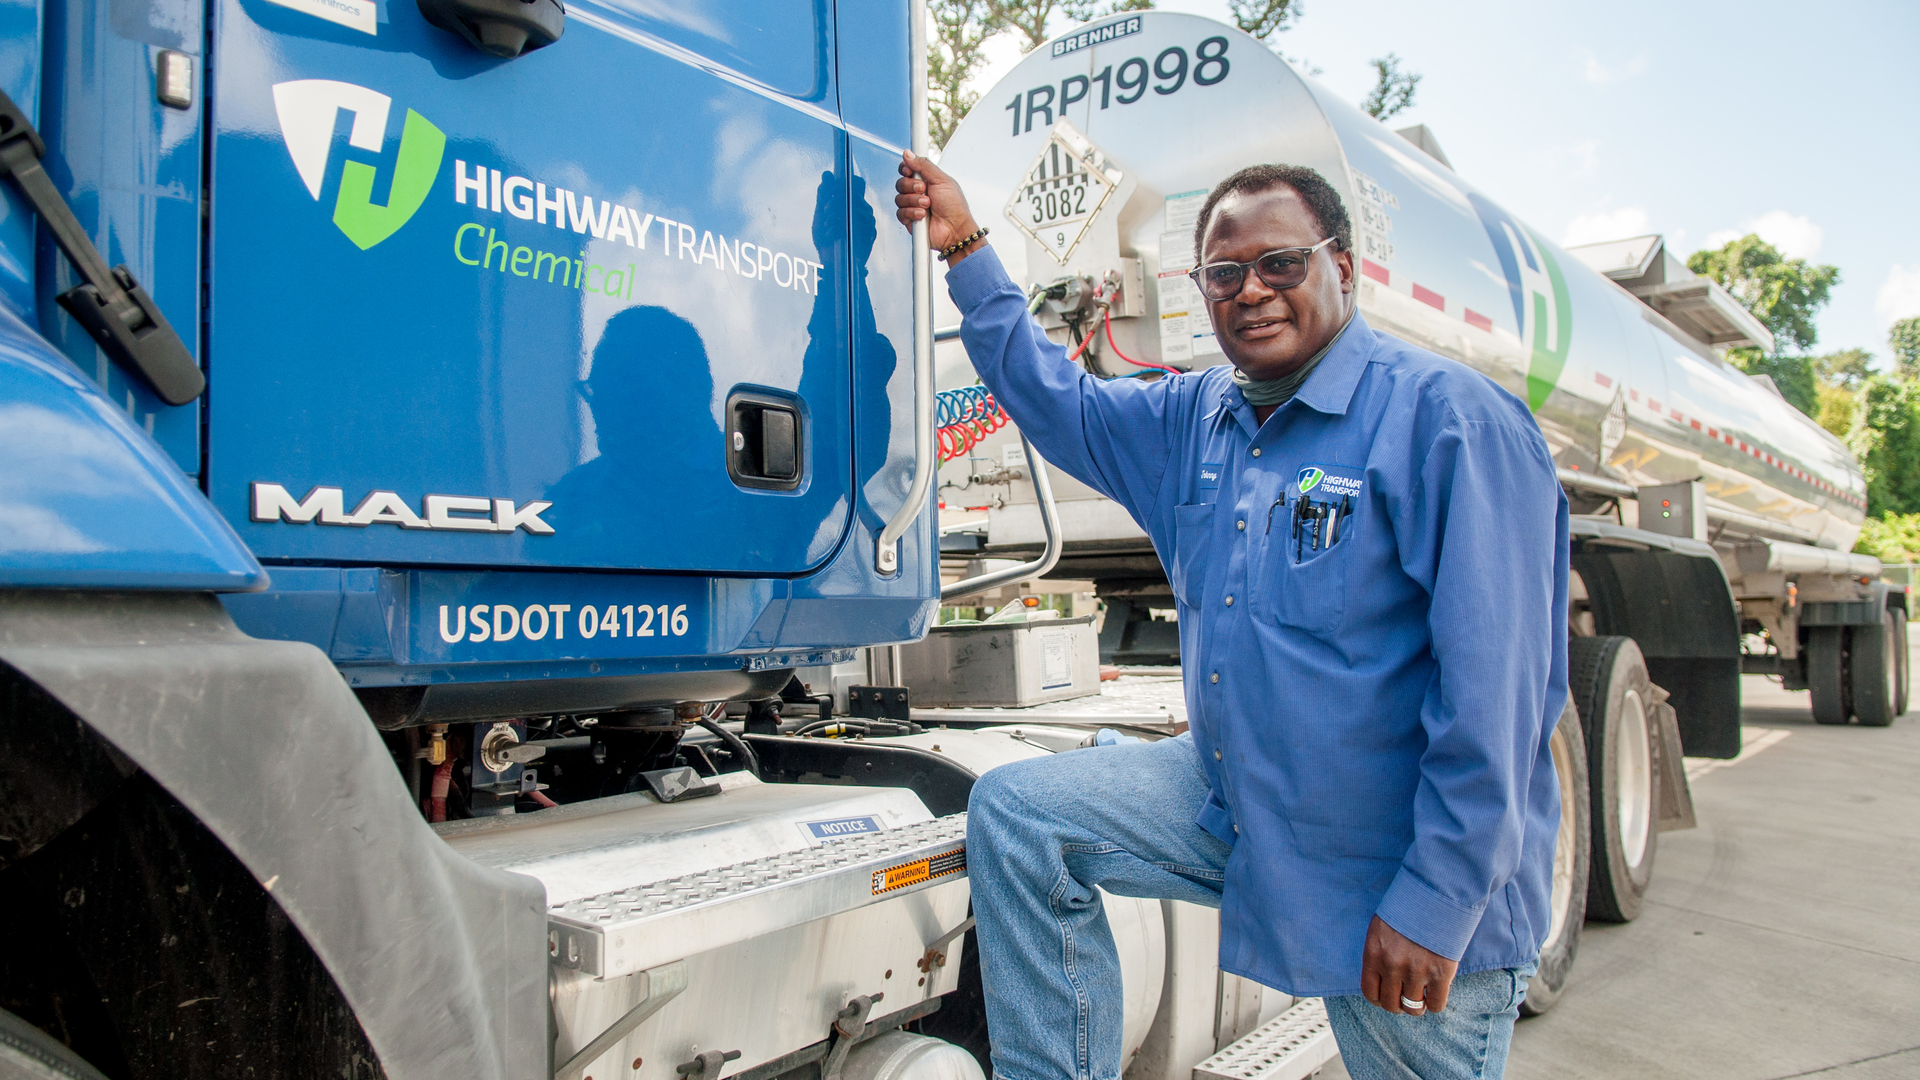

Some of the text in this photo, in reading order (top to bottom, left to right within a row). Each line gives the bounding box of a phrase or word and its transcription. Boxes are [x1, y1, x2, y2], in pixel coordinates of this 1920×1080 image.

[1053, 17, 1140, 56] BRENNER
[1005, 36, 1231, 137] 1RP1998
[1032, 185, 1086, 223] 3082
[455, 159, 824, 296] HIGHWAY TRANSPORT
[1056, 232, 1065, 246] 9
[454, 222, 636, 301] Chemical
[251, 481, 556, 536] MACK
[1320, 483, 1360, 498] TRANSPOR
[439, 603, 689, 644] USDOT 041216
[820, 820, 868, 835] NOTICE
[895, 865, 926, 881] WARNING
